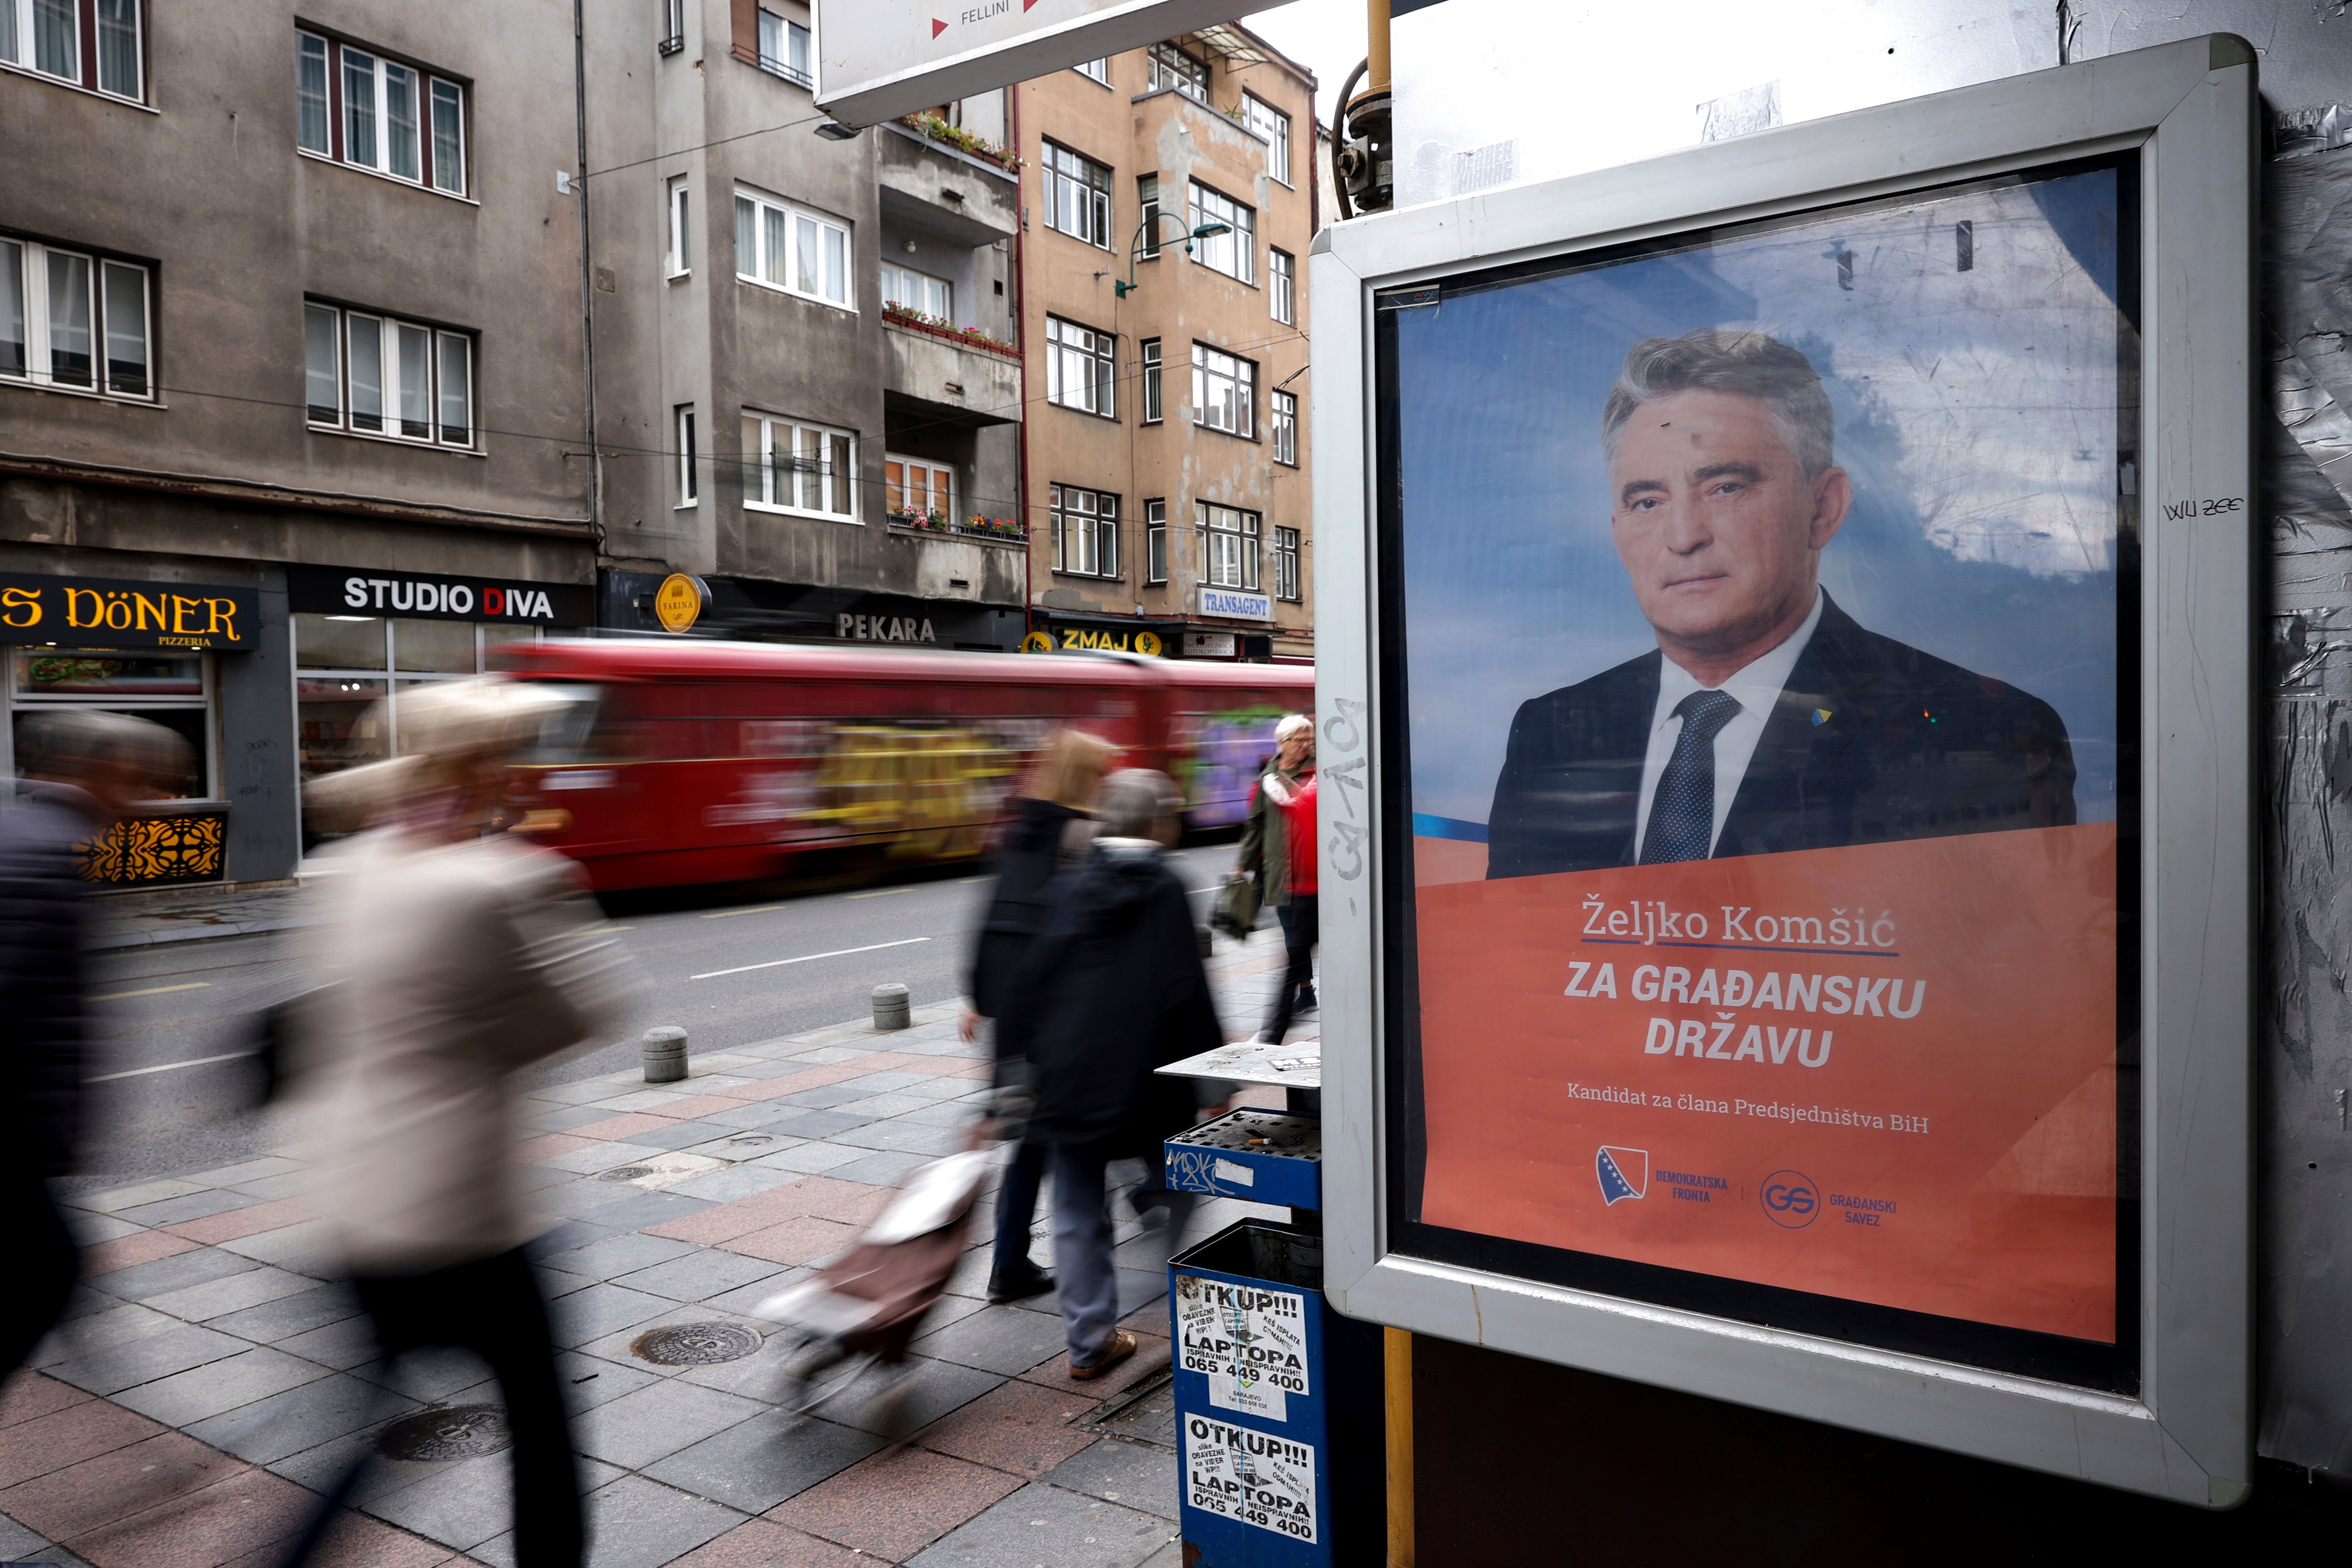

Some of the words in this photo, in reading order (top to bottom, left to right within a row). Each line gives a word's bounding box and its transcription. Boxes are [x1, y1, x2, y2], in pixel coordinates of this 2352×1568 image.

[962, 0, 1009, 24] FELLINI
[344, 577, 473, 613] STUDIO
[483, 588, 554, 618] DIVA
[663, 601, 693, 610] FARINA
[1204, 593, 1267, 616] TRANSAGENT
[836, 613, 935, 641] PEKARA
[158, 637, 211, 646] PIZZERIA
[1063, 629, 1128, 651] ZMAJ
[1582, 894, 1708, 946] Željko
[1721, 906, 1896, 947] Komšić
[1564, 961, 1617, 999] ZA
[1631, 965, 1926, 1019] GRAĐANSKU
[1644, 1012, 1833, 1068] DRŽAVU
[1567, 1083, 1647, 1106] Kandidat
[1652, 1095, 1672, 1109] za
[1677, 1093, 1729, 1113] člana
[1734, 1099, 1884, 1129] Predsjedništva
[1890, 1114, 1930, 1134] BiH
[1656, 1170, 1728, 1190] DEMOKRATSKA
[1673, 1187, 1710, 1203] FRONTA
[1830, 1194, 1896, 1214] GRAĐANSKI
[1845, 1211, 1880, 1227] SAVEZ
[1195, 1317, 1215, 1326] VIBER
[1264, 1315, 1276, 1327] KEŠ
[1277, 1324, 1300, 1346] ISPLATA
[1184, 1333, 1303, 1370] LAPTOPA
[1187, 1348, 1230, 1362] ISPRAVNIH
[1186, 1356, 1219, 1373] 065
[1226, 1364, 1260, 1382] 449
[1268, 1374, 1304, 1391] 400
[1233, 1391, 1261, 1401] SARAJEVO
[1191, 1419, 1307, 1468] OTKUP!!!
[1192, 1449, 1225, 1459] OBAVEZNE
[1193, 1471, 1311, 1518] LAPTOPA
[1195, 1486, 1238, 1503] ISPRAVNIH
[1286, 1472, 1309, 1494] ISPLA
[1193, 1493, 1226, 1513] 065
[1234, 1507, 1268, 1526] 449
[1277, 1519, 1312, 1539] 400
